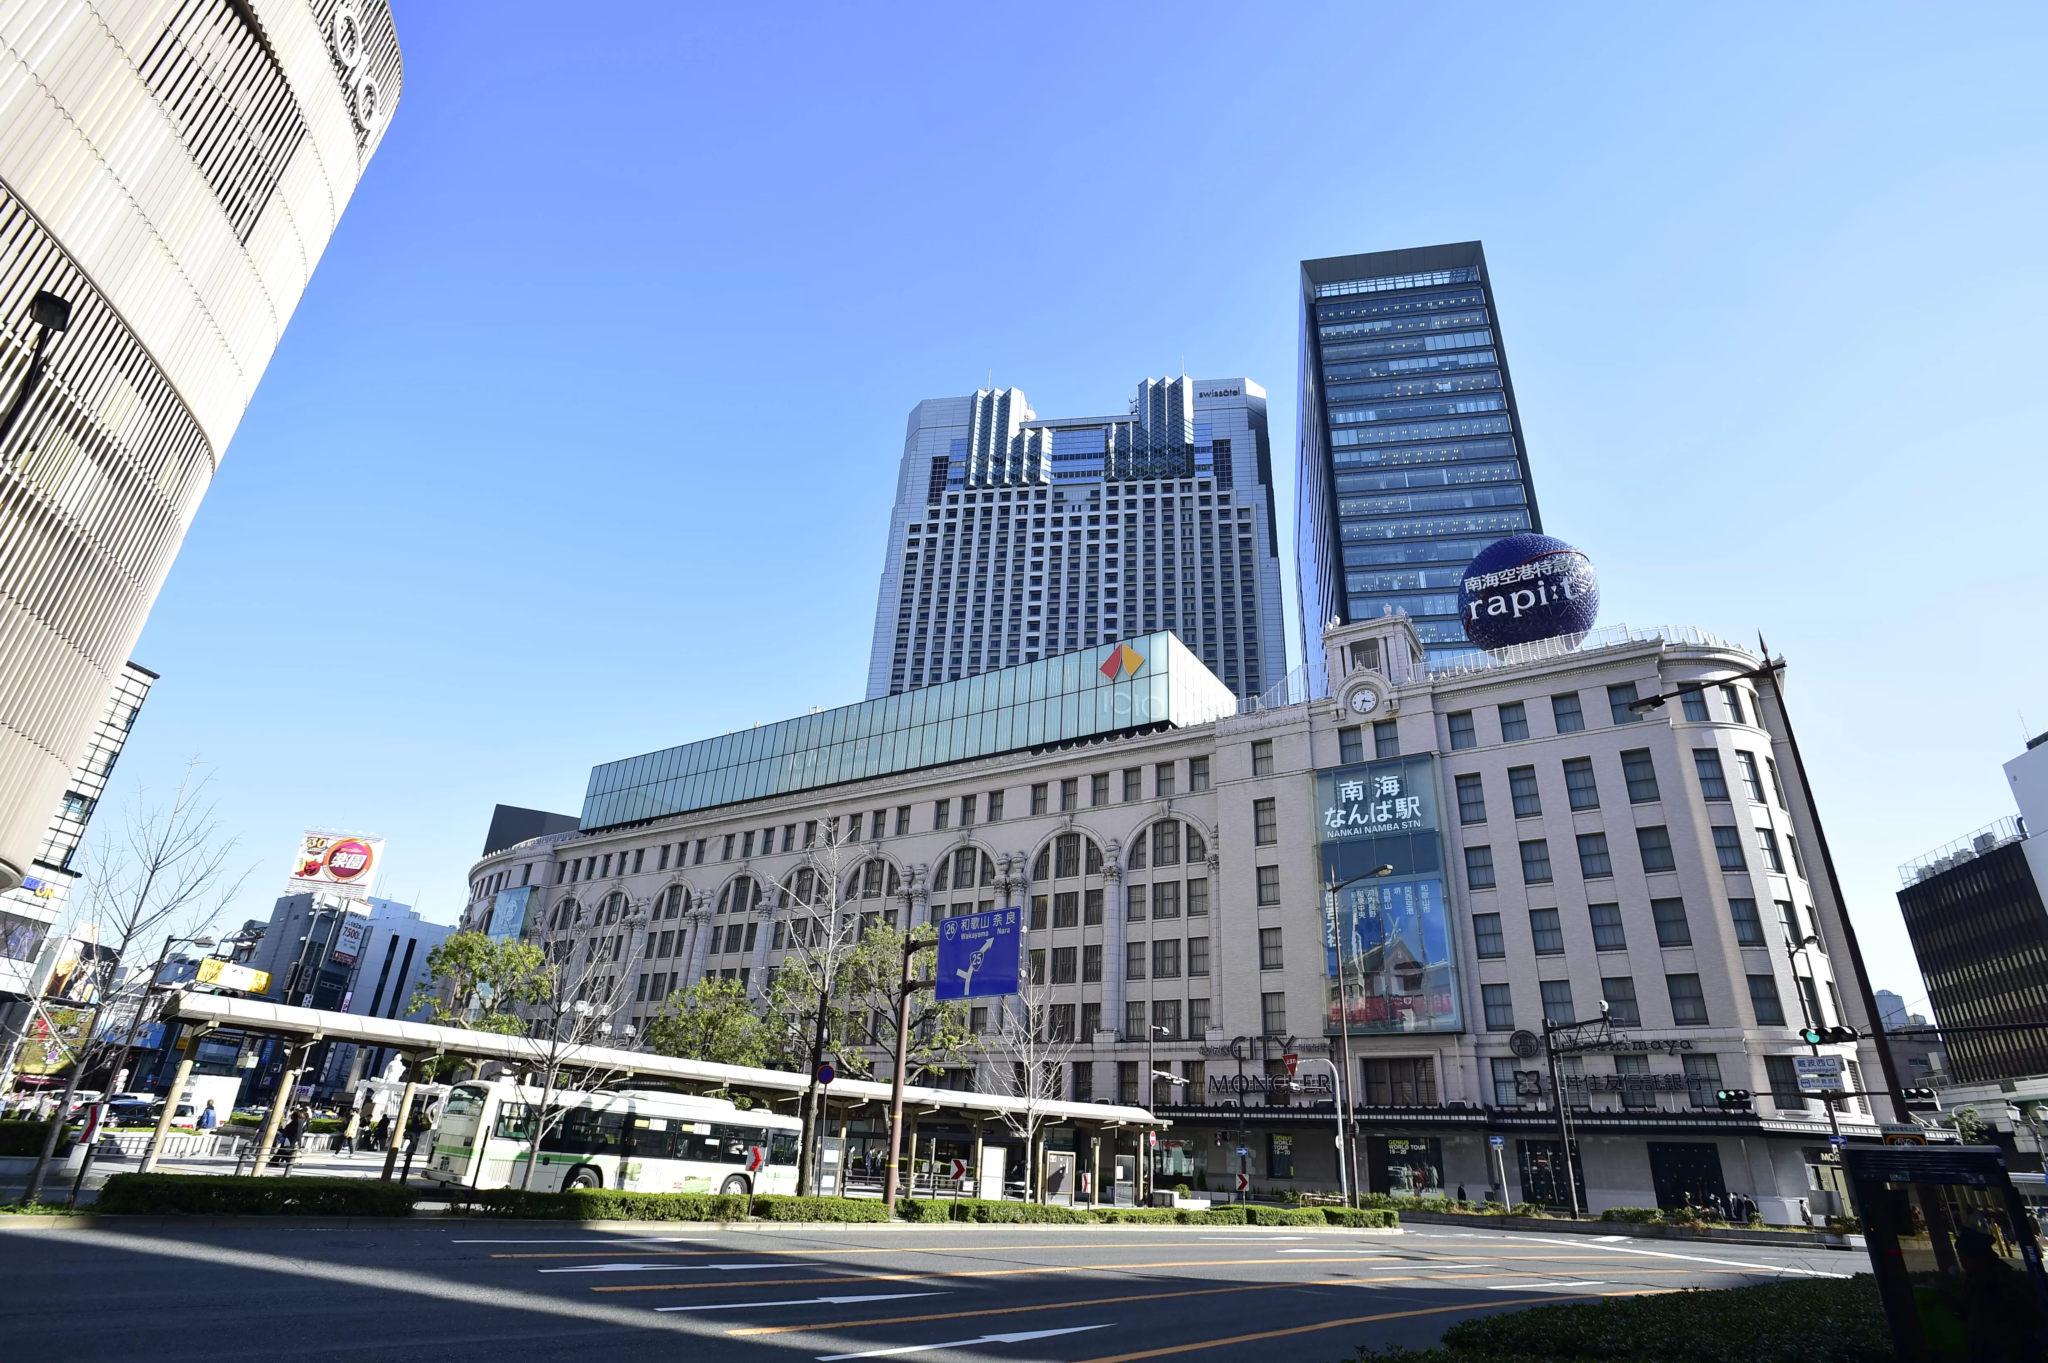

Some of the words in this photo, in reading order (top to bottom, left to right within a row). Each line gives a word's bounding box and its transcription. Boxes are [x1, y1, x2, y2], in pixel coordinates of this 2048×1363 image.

[1464, 558, 1570, 594] 南海空港特急
[1339, 775, 1400, 803] 南海
[1325, 796, 1422, 828] なんば駅
[1327, 827, 1362, 838] NANKAI
[1364, 822, 1399, 834] NAMBA
[1401, 819, 1424, 830] STN.
[1382, 888, 1392, 910] 高野山
[1393, 887, 1402, 895] 堺
[1404, 886, 1414, 915] 関西空港
[1420, 884, 1431, 914] 和歌山市
[946, 923, 955, 935] 26
[961, 916, 989, 932] 和歌山
[993, 911, 1016, 927] 奈良
[961, 931, 989, 940] Wakayama
[997, 927, 1010, 935] Nara
[972, 953, 982, 965] 25
[1230, 1035, 1297, 1061] CITY
[1797, 1058, 1836, 1068] 難波西口
